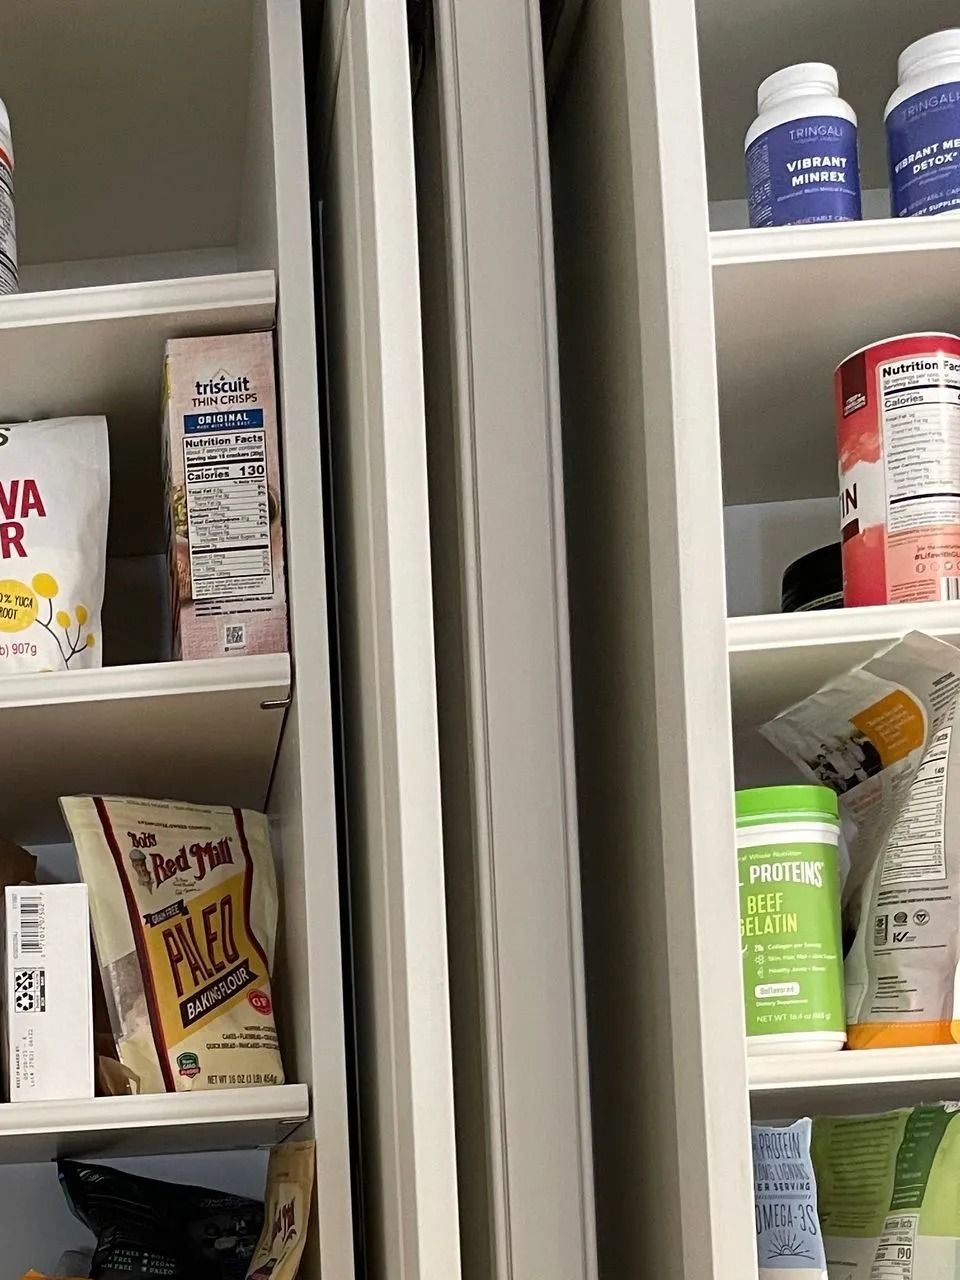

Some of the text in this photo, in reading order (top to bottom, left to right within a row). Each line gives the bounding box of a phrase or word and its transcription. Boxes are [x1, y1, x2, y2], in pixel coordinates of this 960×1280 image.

[787, 157, 847, 172] VIBRANT
[894, 144, 938, 174] VIBRANT
[792, 172, 845, 186] MINREX
[882, 361, 939, 377] Nutrition
[195, 376, 250, 396] triscuit
[192, 393, 257, 408] THIN CRISPS
[884, 394, 924, 408] Calories
[198, 413, 249, 425] ORIGINAL
[185, 434, 263, 449] Nutrition Facts
[188, 465, 265, 481] Calories 130
[14, 594, 34, 610] YUCA
[11, 643, 37, 657] 907g
[149, 844, 192, 889] Red
[189, 837, 234, 881] Mill
[749, 861, 823, 888] PROTEINS
[747, 892, 783, 915] BEEF
[162, 894, 240, 998] PALEO
[187, 967, 249, 1020] BAKING FLOUR
[756, 1014, 788, 1024] NET WT
[207, 1075, 218, 1085] NET
[758, 1132, 801, 1160] PROTEIN
[773, 1182, 811, 1191] SERVING
[897, 1247, 912, 1259] 190
